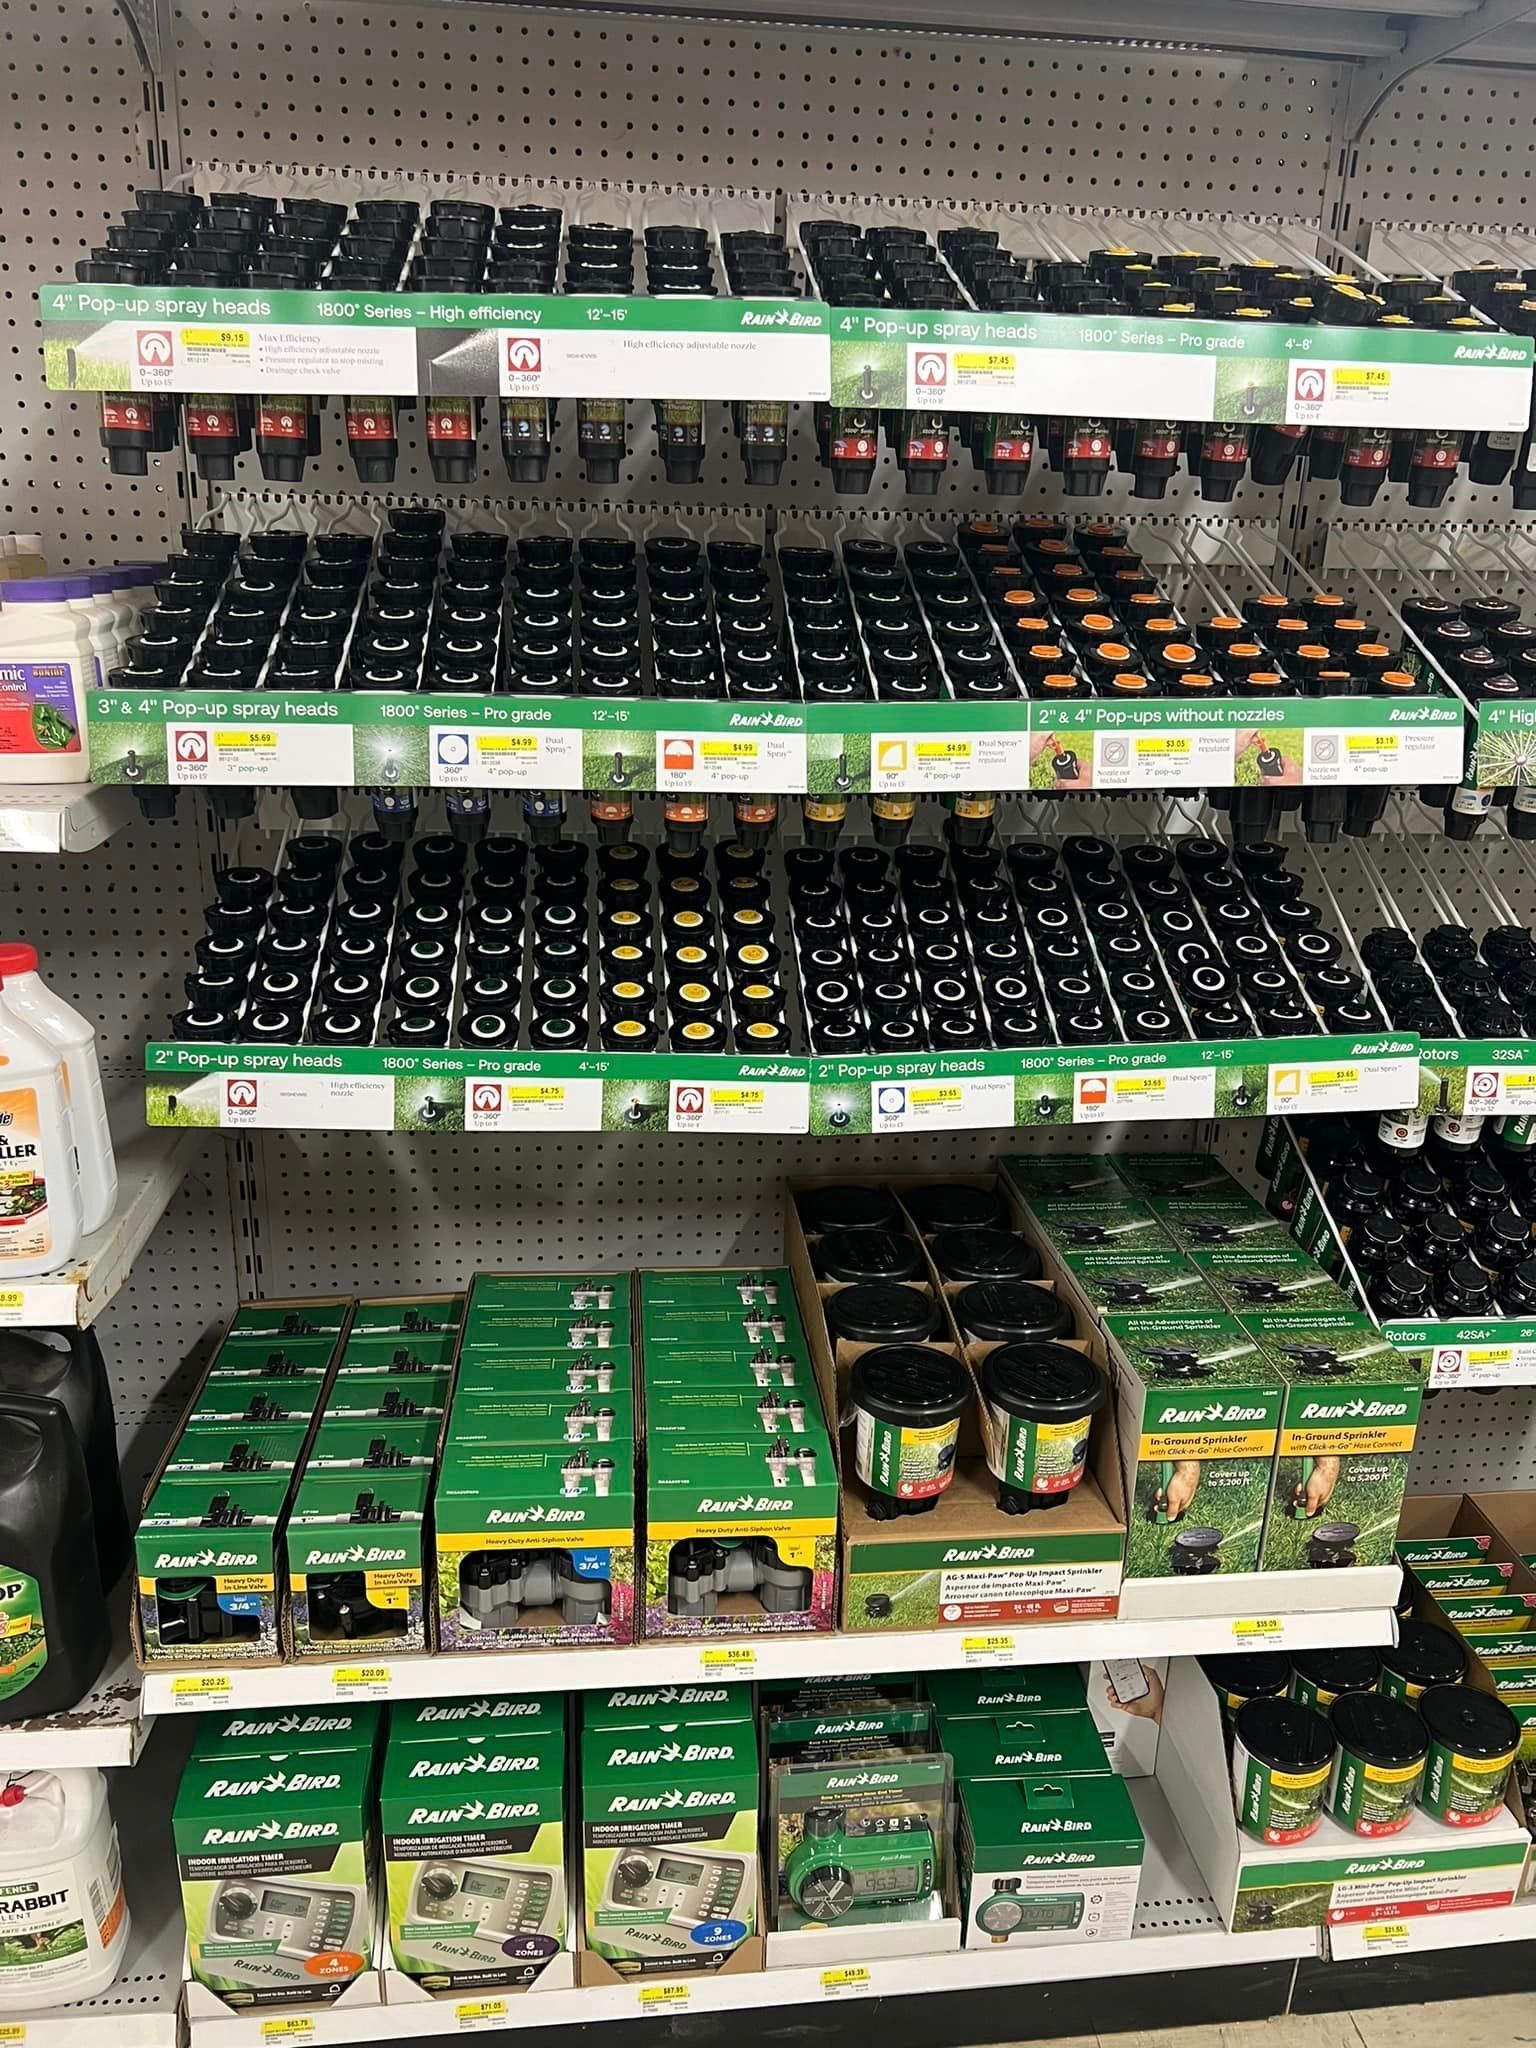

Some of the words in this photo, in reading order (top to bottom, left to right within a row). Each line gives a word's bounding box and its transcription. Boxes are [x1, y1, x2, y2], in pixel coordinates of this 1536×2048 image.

[52, 296, 73, 311] 4"
[78, 296, 151, 315] Pop-up
[155, 299, 207, 318] spray
[213, 298, 271, 316] heads
[364, 304, 412, 319] Series
[430, 305, 464, 323] High
[469, 306, 542, 323] efficiency
[741, 311, 776, 326] RAIN
[789, 313, 822, 327] BIRD
[840, 317, 859, 332] 4"
[864, 317, 927, 338] Pop-up
[933, 321, 980, 340] spray
[985, 323, 1037, 340] heads
[221, 333, 244, 343] $9.15
[259, 333, 277, 343] Max
[280, 334, 321, 344] Efficiency
[1121, 330, 1164, 344] Series
[1180, 334, 1202, 347] Pro
[1206, 335, 1245, 350] grade
[624, 340, 643, 349] High
[646, 341, 684, 350] efficiency
[686, 341, 728, 350] adjustable
[1454, 345, 1485, 359] RAIN
[1498, 347, 1527, 361] BIRD
[988, 356, 1009, 365] $7.45
[98, 700, 117, 714] 3"
[121, 702, 132, 714] &
[139, 700, 157, 714] 4"
[163, 701, 227, 718] Pop-up
[232, 702, 280, 720] spray
[285, 702, 338, 717] heads
[424, 706, 467, 719] Series
[484, 708, 507, 720] Pro
[511, 709, 551, 722] grade
[1389, 709, 1420, 721] RAIN
[1430, 709, 1456, 720] BIRD
[1488, 709, 1506, 723] 4"
[730, 713, 760, 726] RAIN
[774, 715, 803, 728] BIRD
[1039, 710, 1056, 724] 2"
[1059, 712, 1068, 723] &
[1074, 710, 1092, 723] 4"
[1096, 709, 1161, 726] Pop-ups
[1166, 709, 1226, 723] without
[1230, 709, 1284, 722] nozzles
[250, 734, 271, 742] $5.69
[511, 738, 532, 746] $4.99
[1165, 740, 1185, 748] $3.05
[733, 744, 752, 752] $4.99
[947, 744, 967, 752] $4.99
[239, 764, 268, 774] pop-up
[498, 768, 527, 778] pop-up
[1155, 768, 1181, 777] pop-up
[1351, 1043, 1378, 1055] RAIN
[1389, 1042, 1413, 1053] BIRD
[156, 1052, 173, 1064] 2"
[178, 1052, 238, 1068] Pop-up
[243, 1054, 288, 1069] spray
[293, 1054, 342, 1067] heads
[422, 1058, 463, 1070] Series
[479, 1060, 500, 1071] Pro
[504, 1061, 541, 1073] grade
[1057, 1056, 1094, 1067] Series
[1109, 1055, 1128, 1064] Pro
[1133, 1052, 1166, 1067] grade
[739, 1065, 767, 1076] RAIN
[781, 1066, 806, 1077] BIRD
[819, 1065, 834, 1077] 2"
[839, 1063, 892, 1079] Pop-up
[896, 1062, 937, 1076] spray
[941, 1059, 985, 1072] heads
[1336, 1070, 1354, 1078] $3.65
[331, 1082, 347, 1090] High
[349, 1082, 385, 1091] efficiency
[1386, 1330, 1426, 1342] Rotors
[1159, 1408, 1206, 1423] RAIN
[1223, 1406, 1266, 1421] BIRD
[1151, 1437, 1201, 1446] In-Ground
[1204, 1435, 1247, 1445] Sprinkler
[487, 1510, 527, 1523] RAIN
[545, 1509, 585, 1522] BIRD
[155, 1554, 198, 1568] RAIN
[216, 1552, 257, 1566] BIRD
[942, 1549, 982, 1562] RAIN
[998, 1547, 1034, 1559] BIRD
[1039, 1569, 1065, 1577] Impact
[1067, 1568, 1102, 1576] Sprinkler
[201, 1678, 225, 1686] $20.25
[827, 1777, 857, 1789] RAIN
[868, 1773, 899, 1784] BIRD
[608, 1797, 663, 1812] RAIN
[684, 1792, 736, 1808] BIRD
[408, 1808, 463, 1824] RAIN
[486, 1803, 540, 1820] BIRD
[202, 1828, 257, 1845] RAIN
[283, 1823, 339, 1839] BIRD
[217, 1855, 259, 1864] IRRIGATION
[261, 1853, 284, 1861] TIMER
[1023, 1854, 1054, 1865] RAIN
[1067, 1853, 1096, 1863] BIRD
[1345, 1862, 1377, 1874] RAIN
[1393, 1859, 1425, 1870] BIRD
[527, 1941, 535, 1949] 6
[704, 1935, 732, 1943] ZONES
[515, 1949, 543, 1957] ZONES
[329, 1958, 338, 1967] 4
[319, 1965, 349, 1975] ZONES
